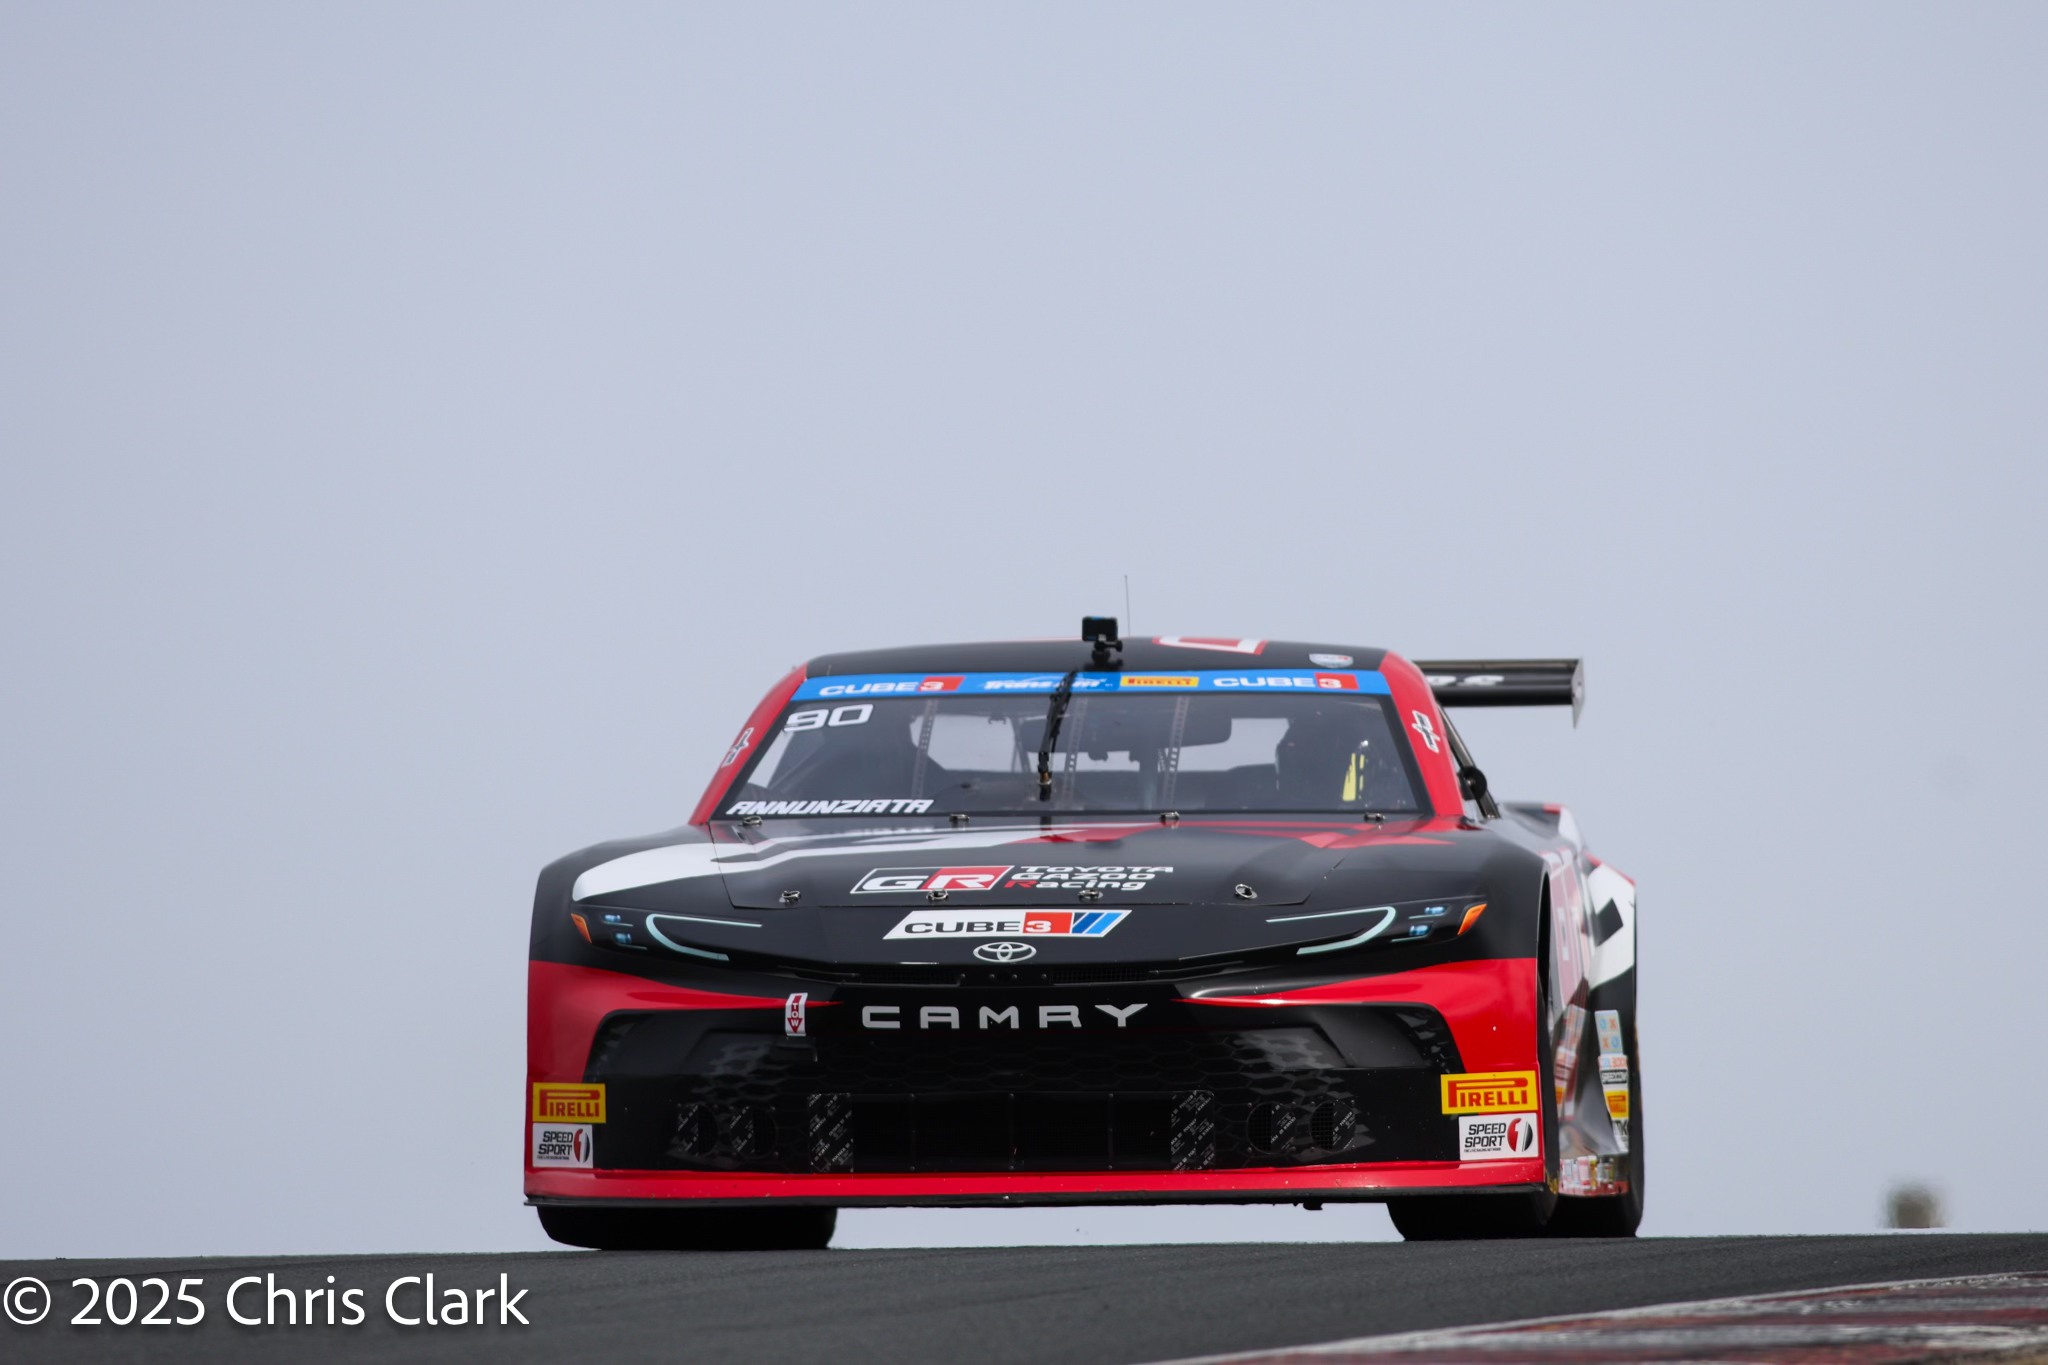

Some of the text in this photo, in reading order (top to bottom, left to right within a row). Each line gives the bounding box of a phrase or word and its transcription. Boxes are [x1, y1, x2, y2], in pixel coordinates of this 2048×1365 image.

[819, 681, 945, 696] CUBE3
[1213, 676, 1343, 689] CUBE3
[783, 703, 874, 732] 90
[726, 799, 934, 816] ANNUNZIATA
[862, 873, 997, 891] GR
[1011, 872, 1156, 880] GAZOO
[1004, 880, 1146, 891] Racing
[904, 919, 1053, 935] CUBE3
[791, 1002, 800, 1027] TOW
[862, 1003, 1148, 1029] CAMRY
[1447, 1077, 1529, 1109] PIRELLI
[539, 1089, 600, 1117] PIRELLI
[1468, 1122, 1507, 1136] SPEED
[542, 1130, 574, 1144] SPEED
[1464, 1135, 1506, 1149] SPORT
[538, 1143, 573, 1156] SPORT
